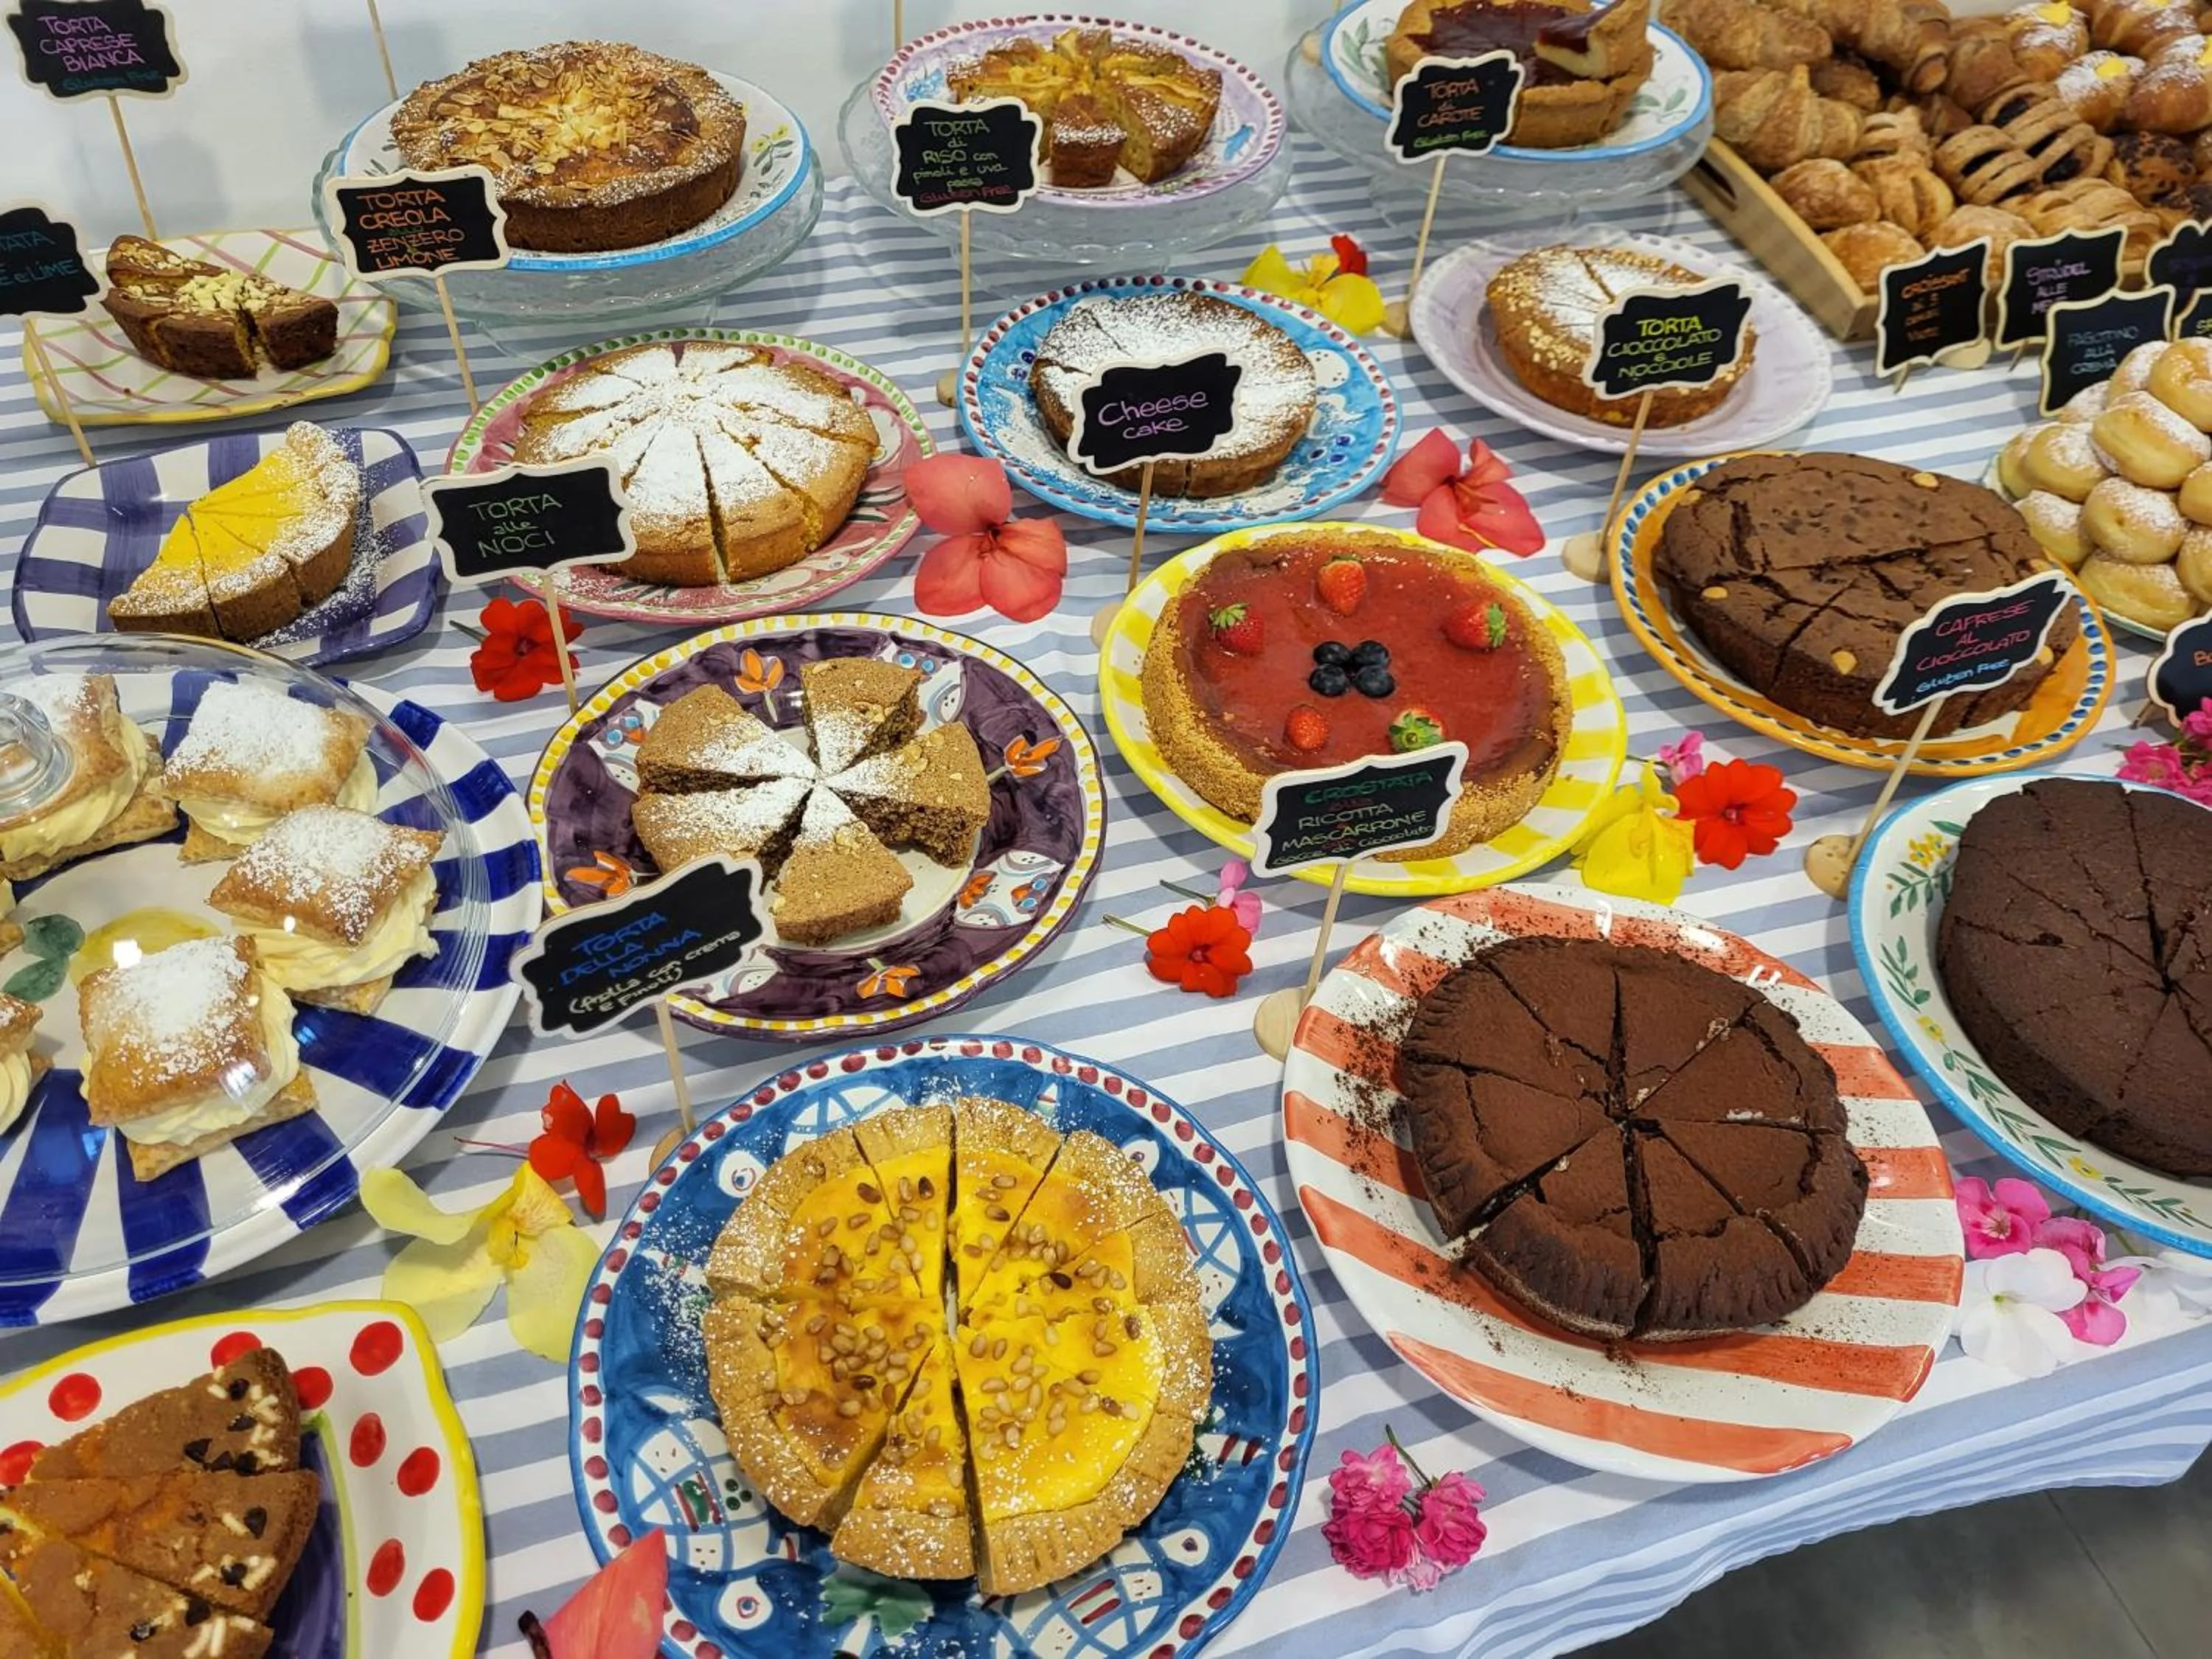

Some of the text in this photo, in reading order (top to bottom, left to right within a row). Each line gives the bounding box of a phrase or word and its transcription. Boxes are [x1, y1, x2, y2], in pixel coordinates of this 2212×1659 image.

[37, 15, 110, 34] TORTA
[39, 33, 138, 55] CAPRESE
[62, 49, 146, 72] BIANCA
[1423, 78, 1480, 99] TORTA
[923, 119, 990, 136] TORTA
[1417, 105, 1486, 128] CAROTE
[947, 136, 967, 148] di
[922, 150, 998, 164] RISO con
[913, 163, 1009, 185] pinoli e uva
[356, 189, 447, 211] TORTA
[919, 184, 1015, 204] Gluten Free
[359, 206, 452, 230] CREOLA
[367, 229, 466, 254] ZENZERO
[1635, 316, 1703, 337] TORTA
[1607, 328, 1722, 358] CIOCCOLATO
[1618, 351, 1714, 378] NOCCIOLE
[1098, 392, 1209, 426] Cheese
[1122, 418, 1189, 439] cake
[467, 493, 563, 521] TORTA
[493, 521, 539, 535] alle
[478, 530, 554, 558] NOCI
[1935, 599, 2035, 636] CAPRESE
[1916, 630, 2030, 672] CIOCCOLATO
[1956, 632, 1980, 647] AL
[1298, 803, 1394, 830] RICOTTA
[1282, 810, 1427, 852] MASCARPONE
[571, 911, 668, 955] TORTA
[559, 942, 644, 985] DELLA
[608, 928, 703, 978] NONNA
[646, 960, 682, 979] con
[684, 931, 742, 961] crema
